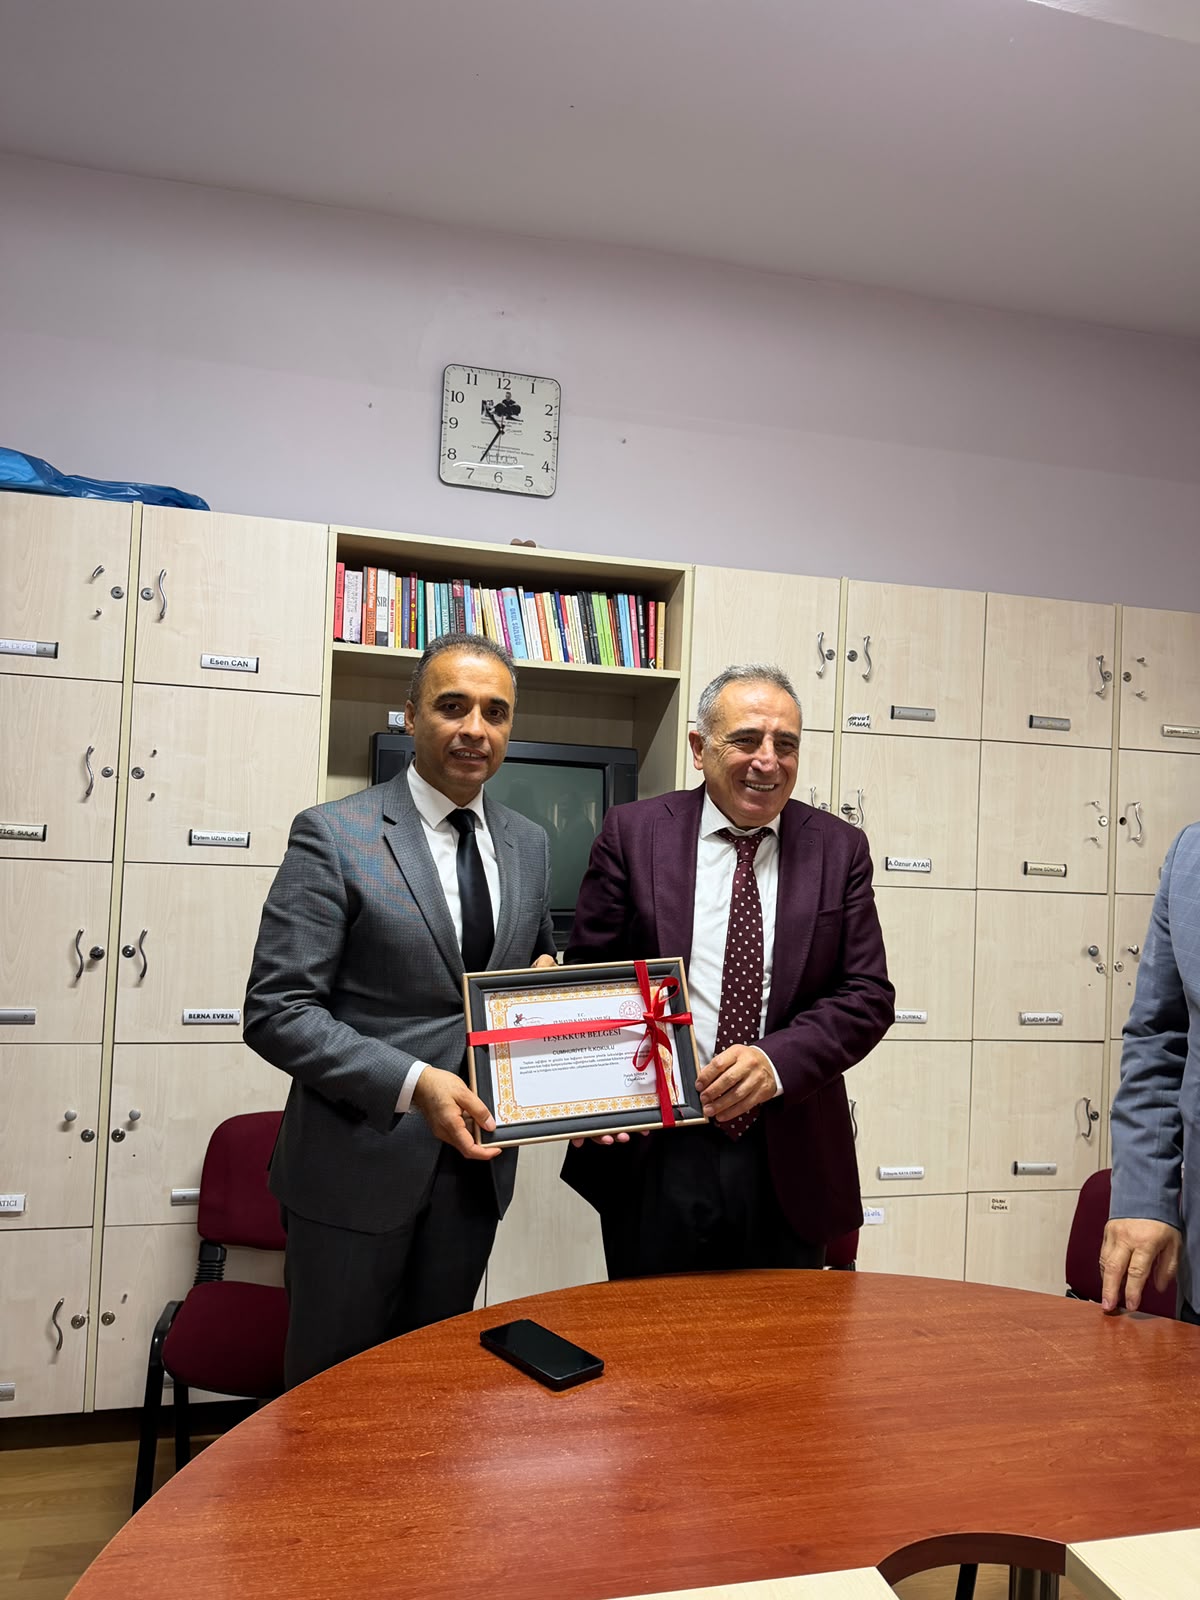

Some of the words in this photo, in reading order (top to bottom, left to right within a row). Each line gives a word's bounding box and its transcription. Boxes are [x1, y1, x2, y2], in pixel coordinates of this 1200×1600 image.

[467, 373, 478, 386] 11
[497, 377, 511, 391] 12
[450, 390, 465, 404] 10
[544, 404, 553, 416] 2
[449, 417, 459, 429] 9
[543, 430, 552, 442] 3
[447, 448, 457, 460] 8
[466, 467, 475, 479] 7
[541, 461, 551, 473] 4
[494, 472, 503, 483] 6
[524, 475, 534, 487] 5
[210, 657, 229, 666] Esen
[231, 659, 249, 668] CAN
[587, 1028, 621, 1038] BELGESİ
[552, 1047, 587, 1056] CUMHURİYET
